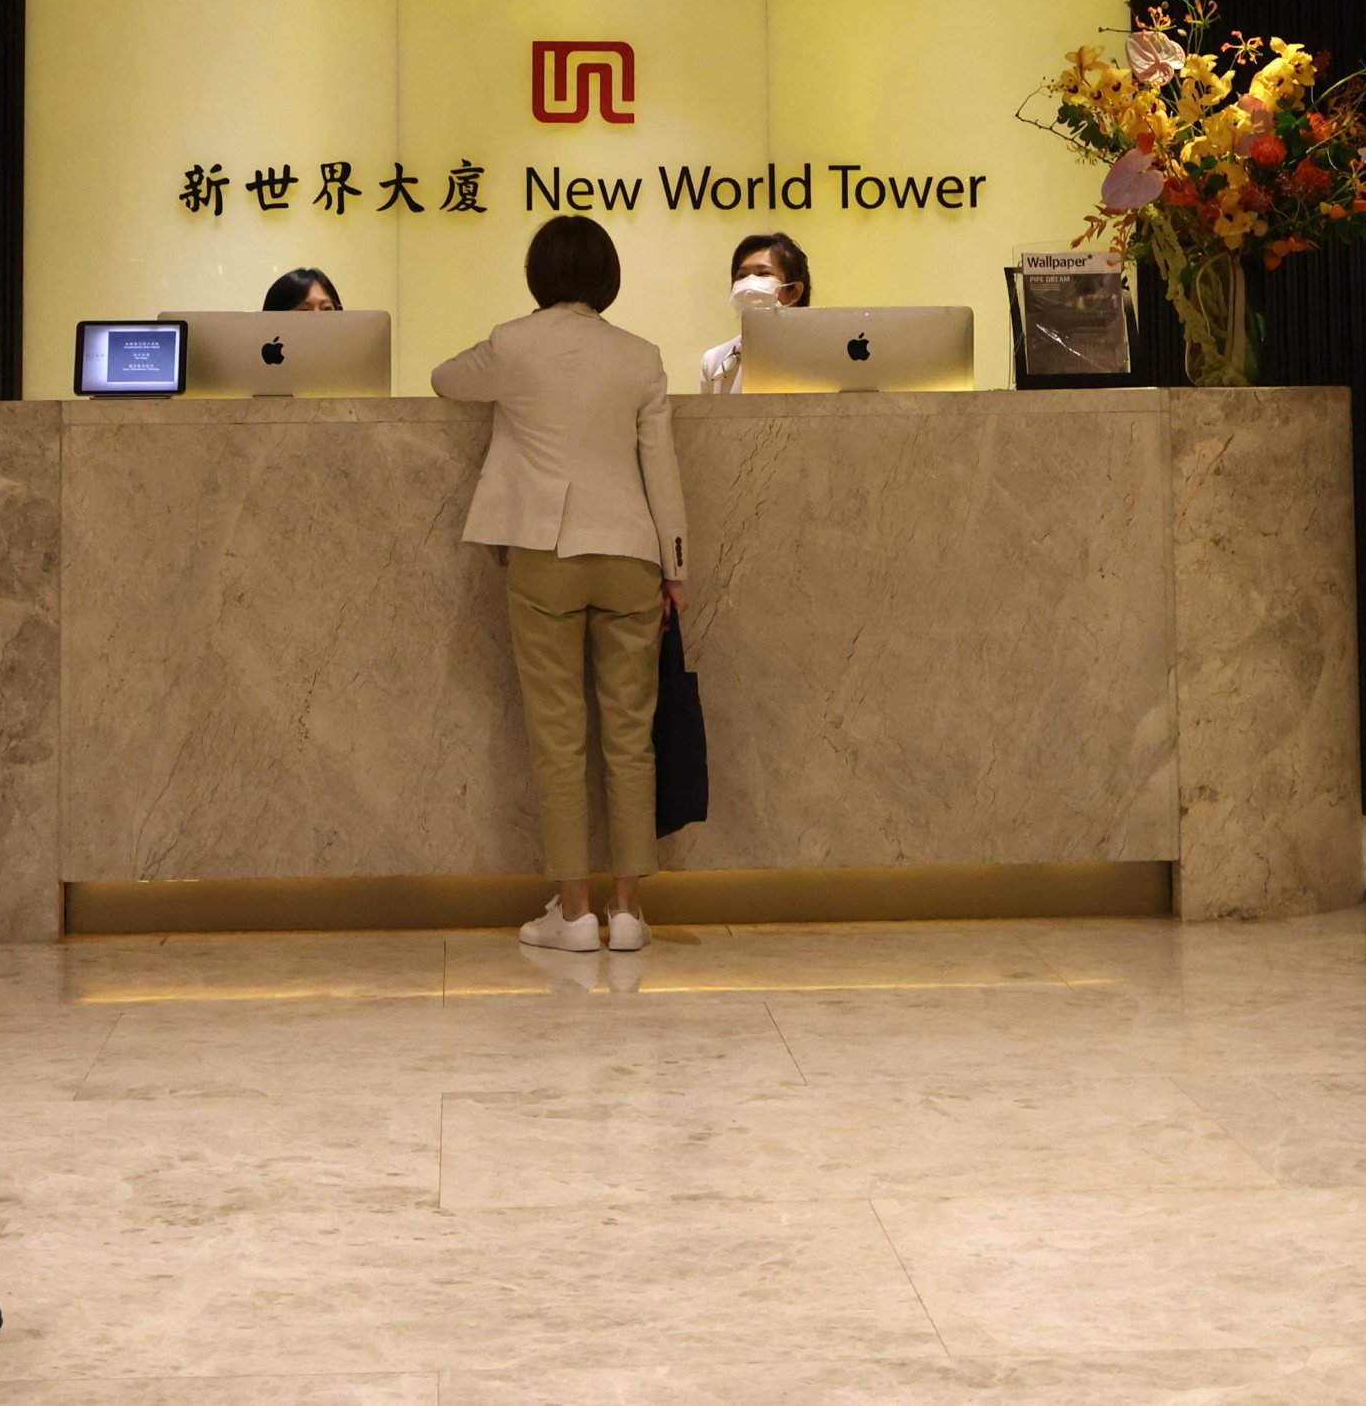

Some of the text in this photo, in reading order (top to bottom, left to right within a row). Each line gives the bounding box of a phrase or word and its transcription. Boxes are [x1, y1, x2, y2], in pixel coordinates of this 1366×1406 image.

[179, 158, 488, 217] 新世界大廈
[526, 163, 987, 211] New World Tower
[1045, 275, 1071, 283] DREAM
